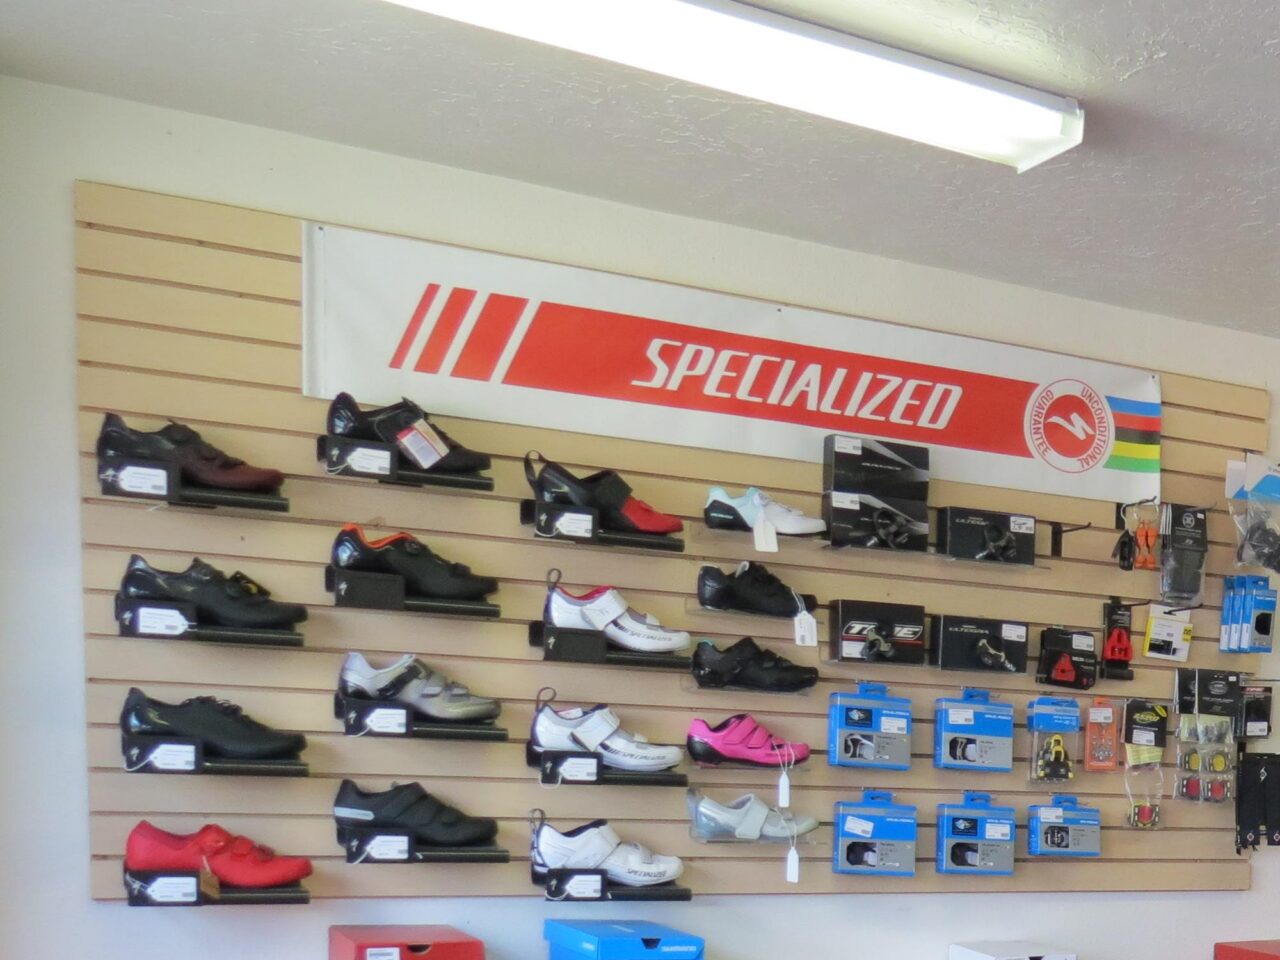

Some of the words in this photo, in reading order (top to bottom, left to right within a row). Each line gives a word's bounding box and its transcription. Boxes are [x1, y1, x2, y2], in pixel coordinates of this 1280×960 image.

[631, 338, 963, 430] SPECIALIZED
[1032, 389, 1054, 457] GUARANTEE
[1077, 386, 1107, 468] UNCONDITIONAL
